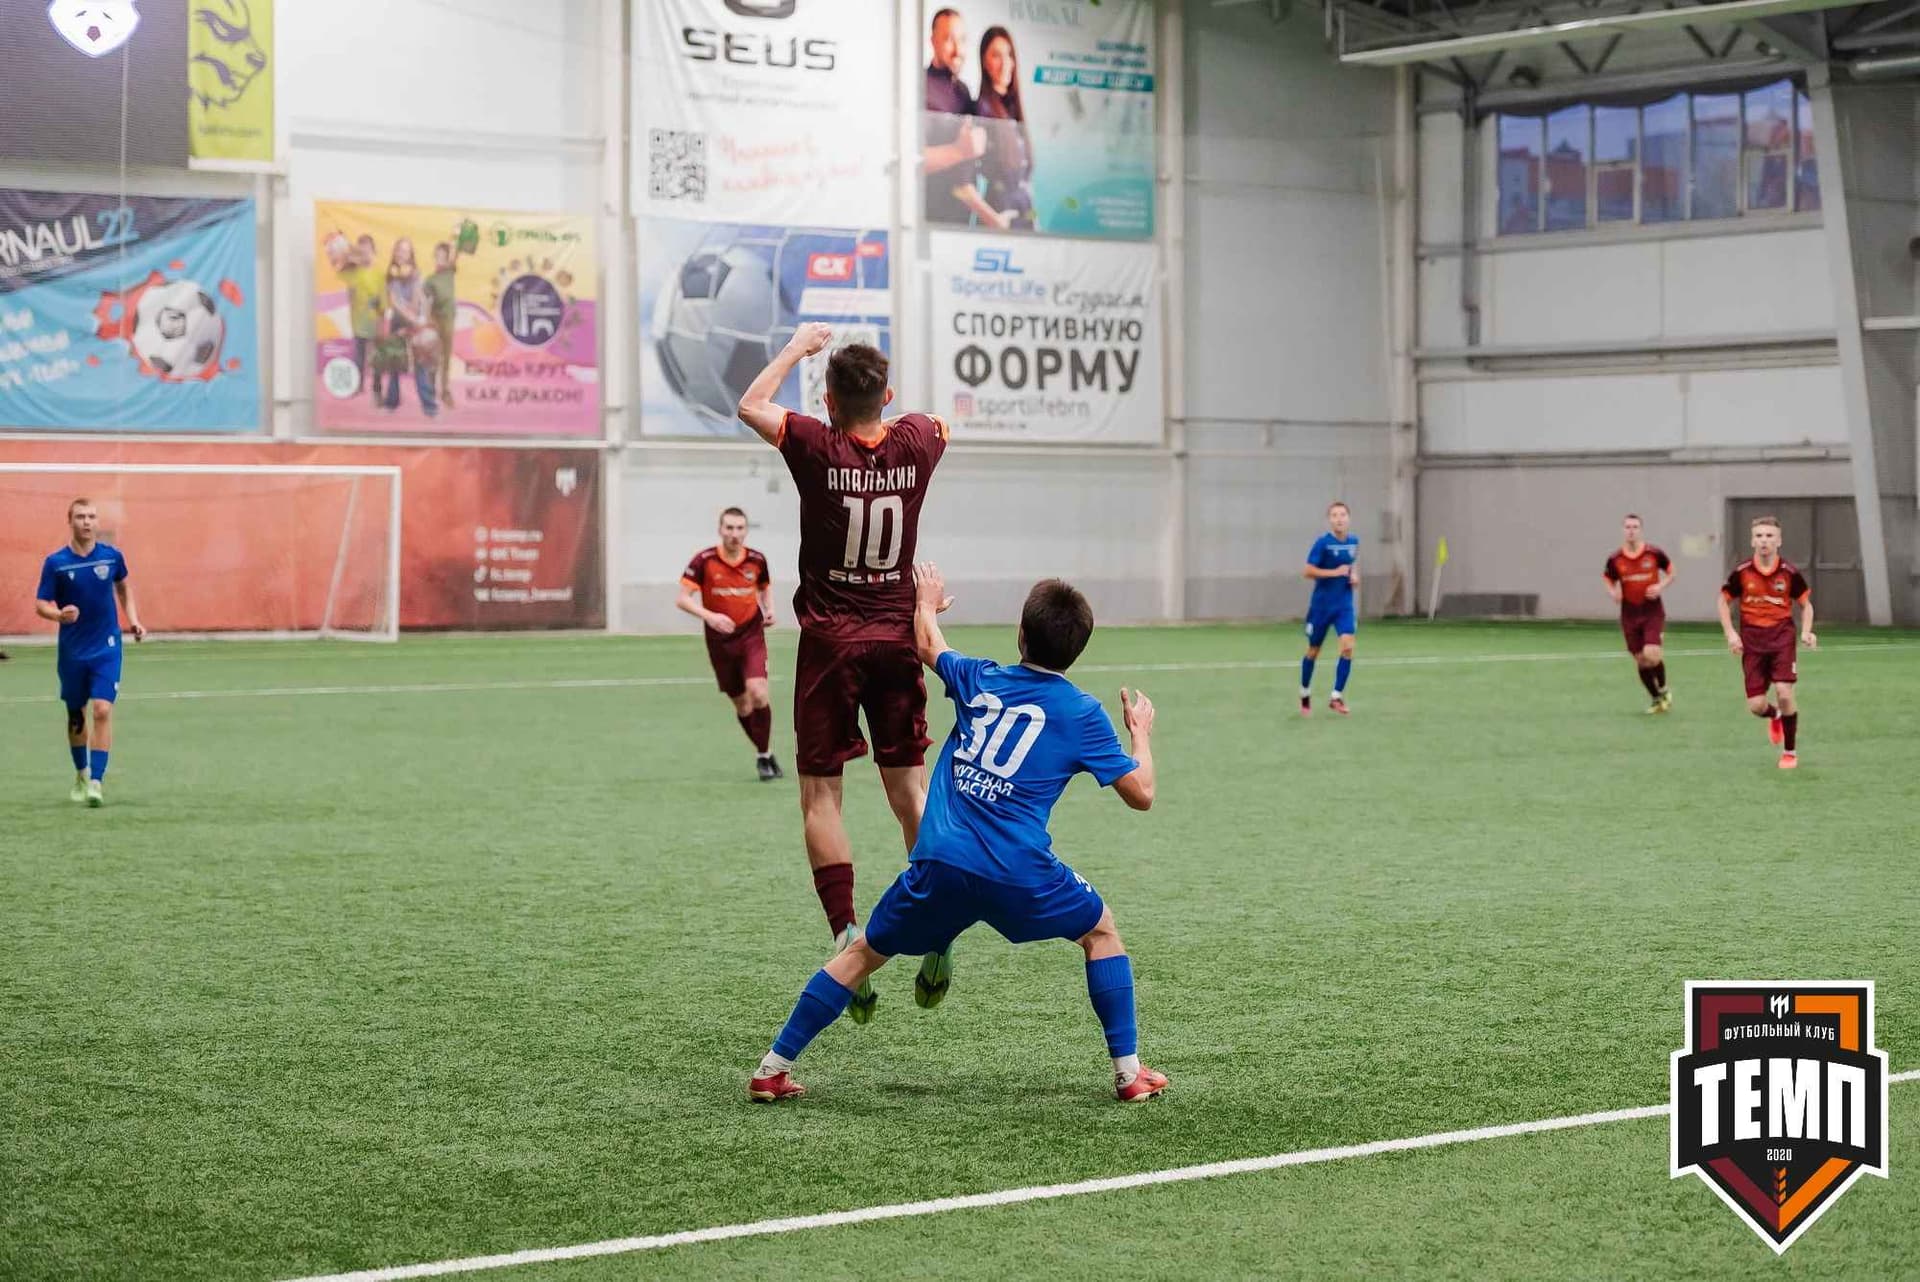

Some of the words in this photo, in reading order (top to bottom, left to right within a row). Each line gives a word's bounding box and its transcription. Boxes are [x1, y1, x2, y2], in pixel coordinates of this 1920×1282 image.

[682, 26, 837, 72] SEUS
[973, 248, 1024, 274] SL
[953, 311, 1143, 343] СПОРТИВНУЮ
[954, 344, 1140, 394] ФОРМУ
[827, 464, 917, 493] АПАЛЬКИН
[842, 494, 904, 570] 10
[953, 692, 1047, 779] 30
